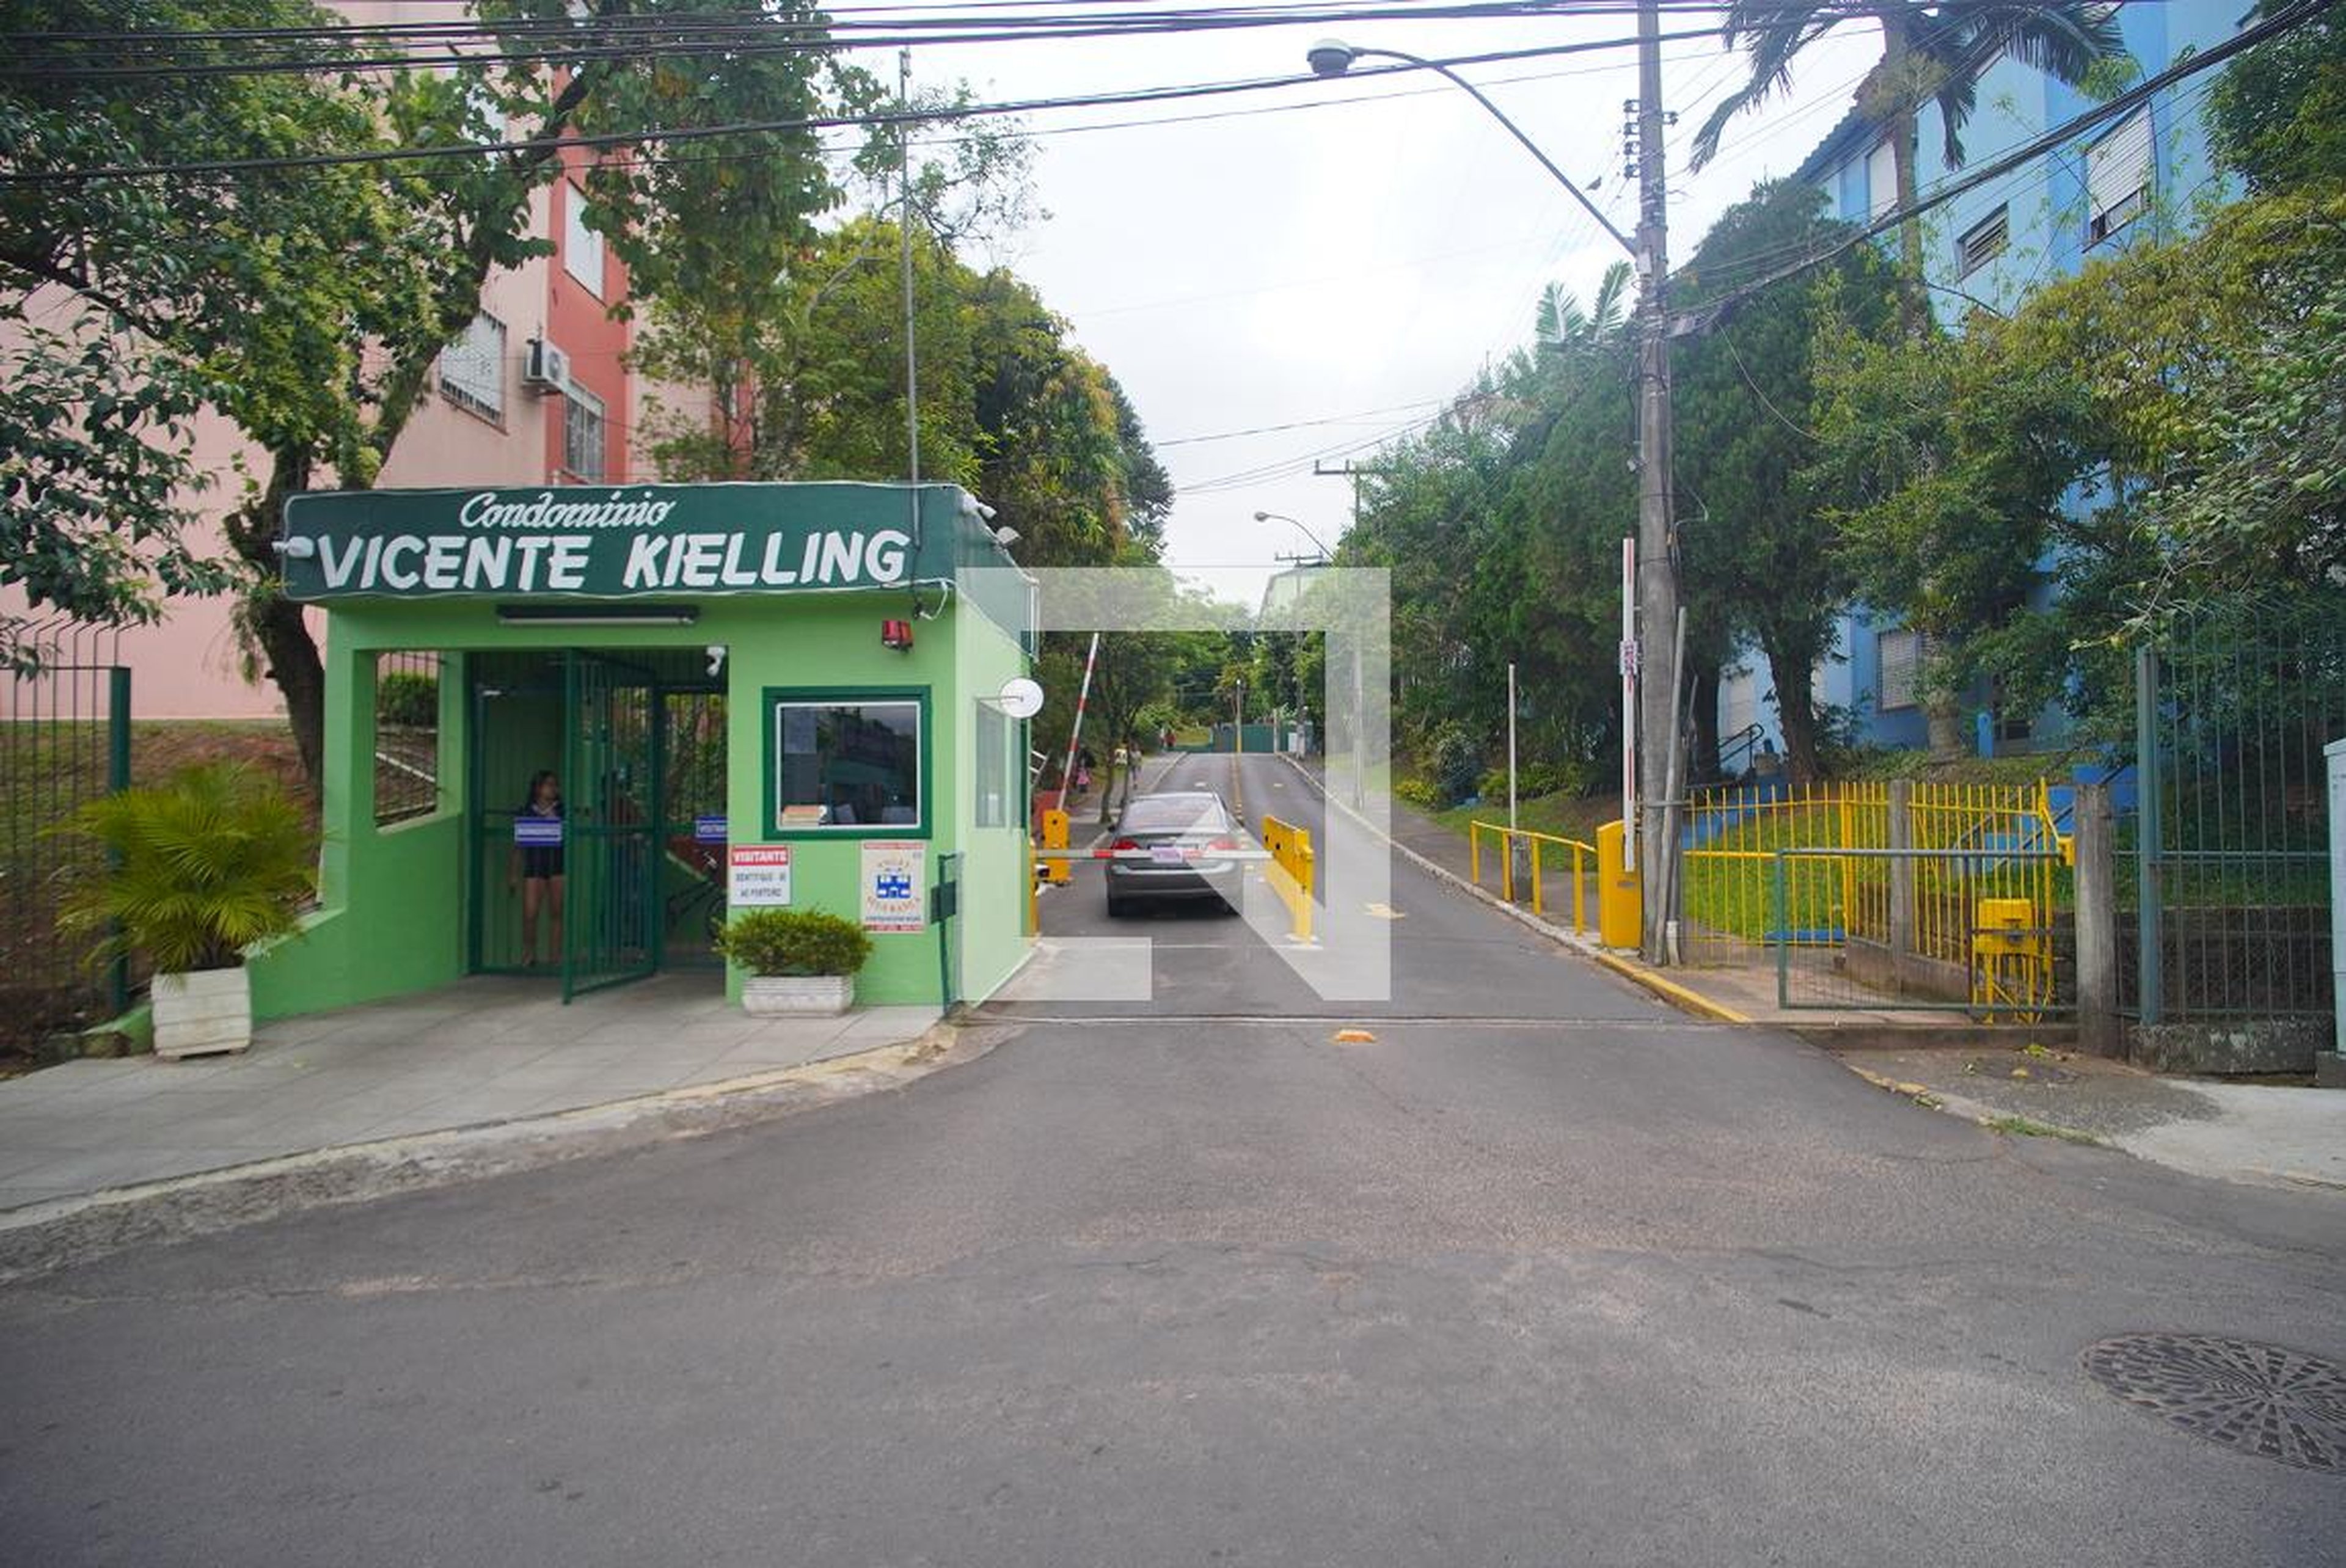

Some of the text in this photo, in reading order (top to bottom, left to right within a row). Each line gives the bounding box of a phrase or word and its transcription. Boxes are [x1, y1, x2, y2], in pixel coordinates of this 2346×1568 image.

[459, 492, 677, 529] Condomínio
[316, 529, 911, 591] VICENTE KIELLING
